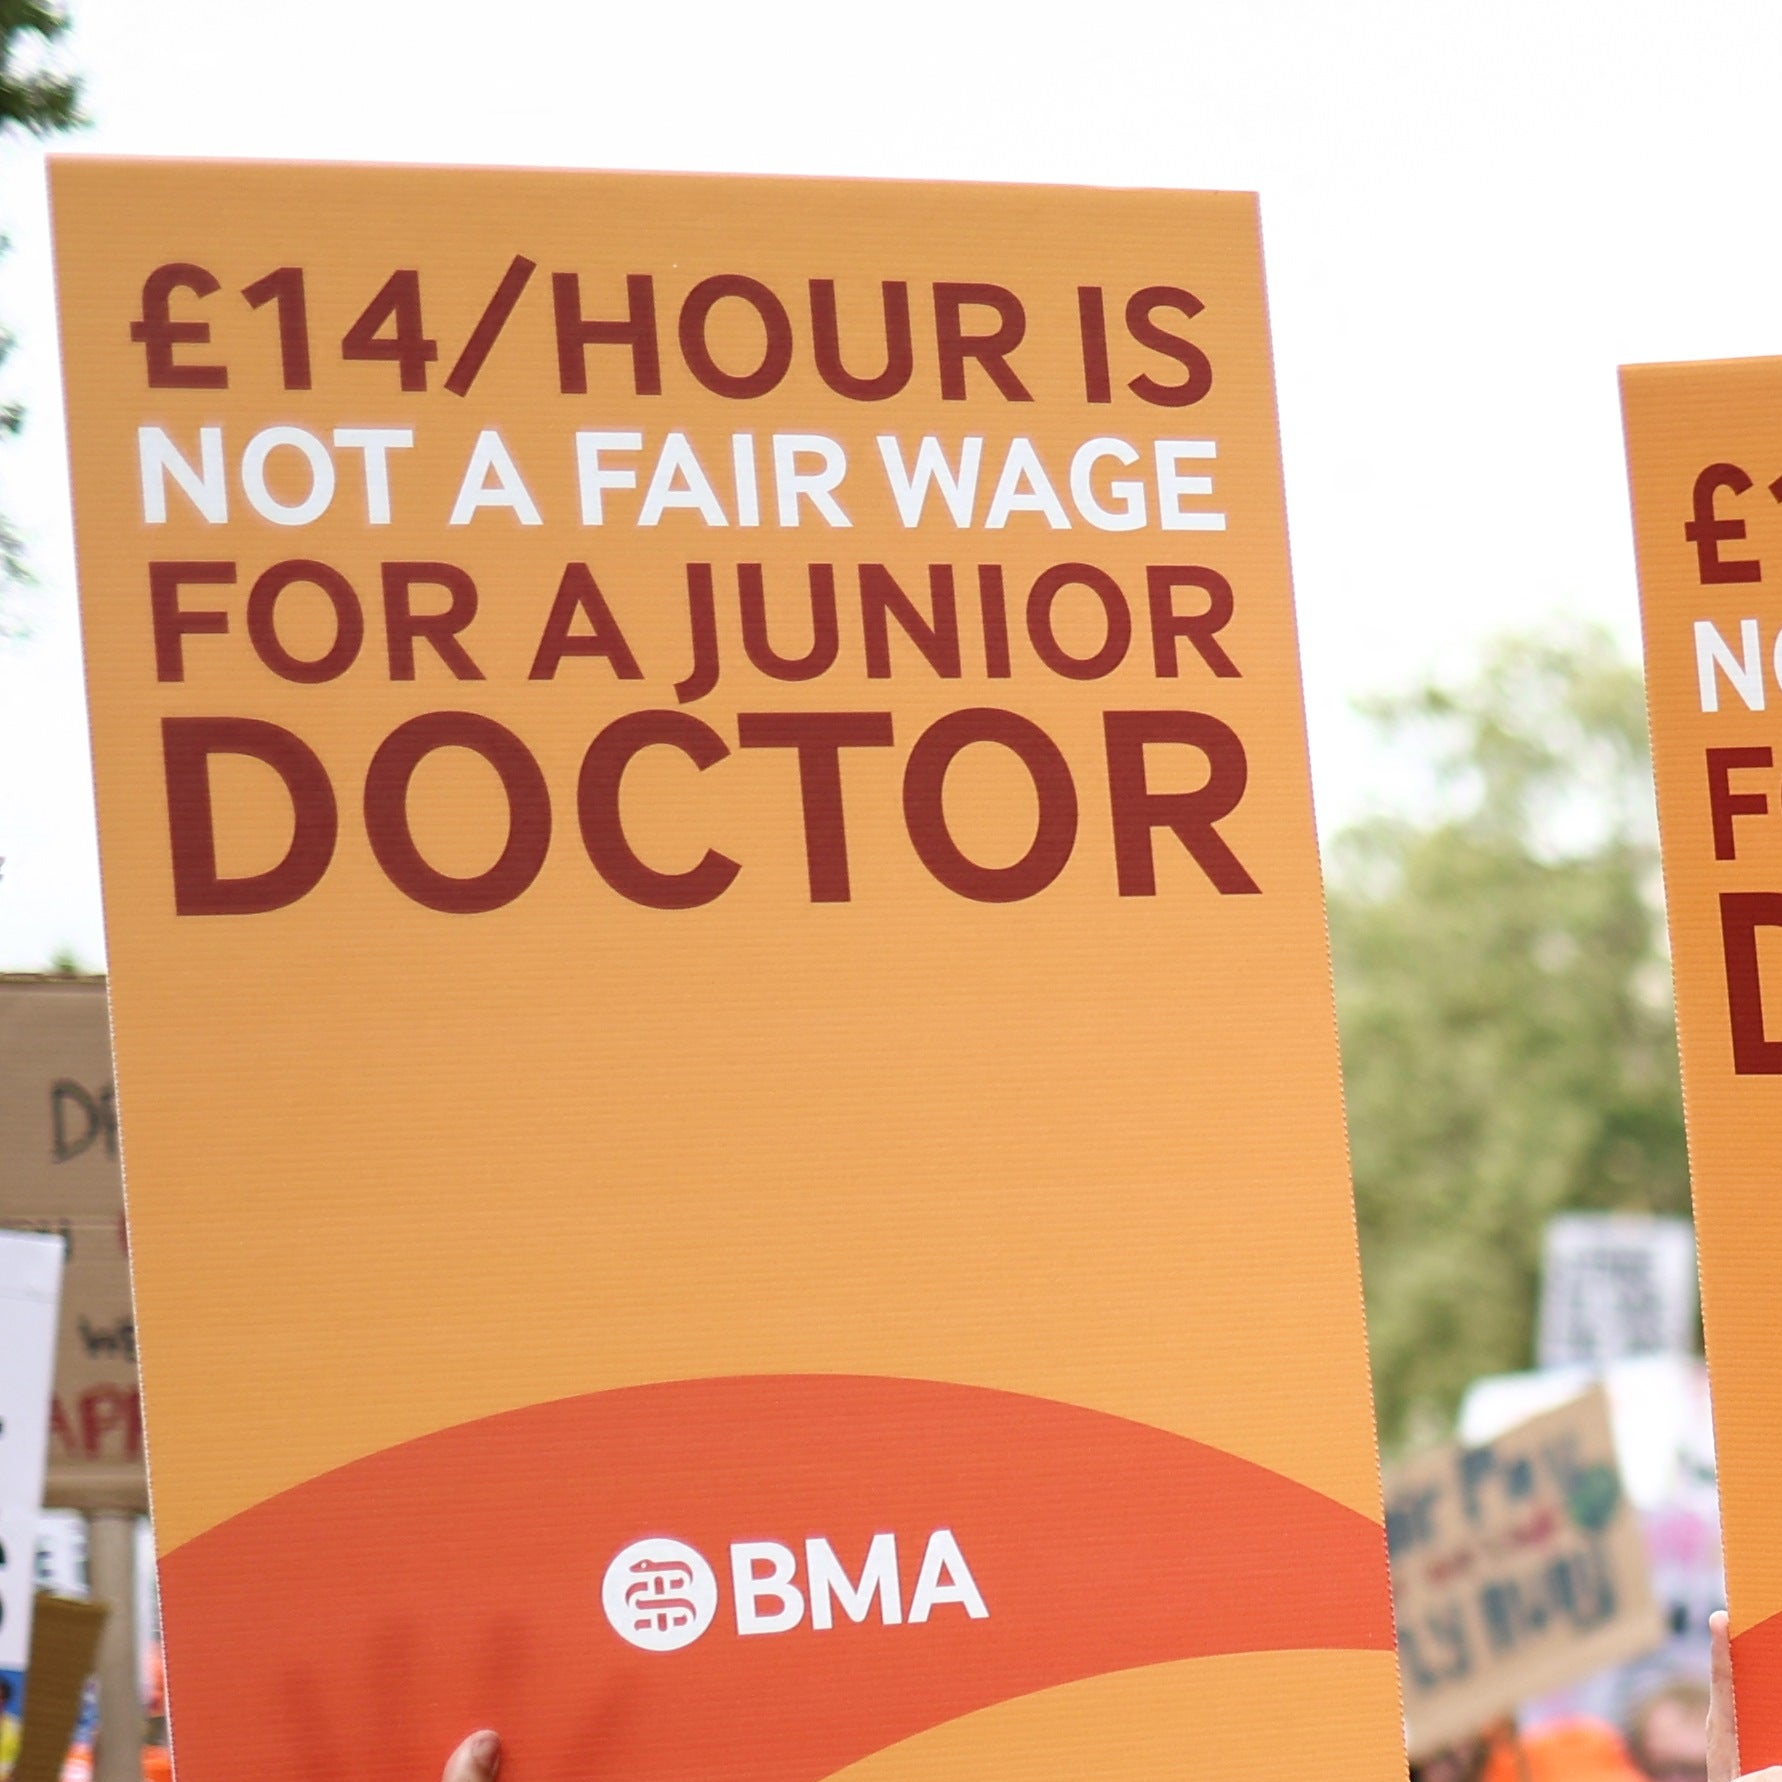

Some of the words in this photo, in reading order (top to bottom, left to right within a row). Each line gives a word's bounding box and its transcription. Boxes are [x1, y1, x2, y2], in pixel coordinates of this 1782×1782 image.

[129, 254, 1035, 403] £14/HOUR
[1077, 285, 1216, 408] IS
[137, 424, 414, 526] NOT
[448, 430, 544, 526] A
[573, 431, 853, 528] FAIR
[876, 434, 1228, 532] WAGE
[147, 558, 486, 684] FOR
[528, 561, 646, 681] A
[673, 561, 1243, 705] JUNIOR
[160, 707, 1264, 917] DOCTOR
[730, 1529, 990, 1636] BMA
